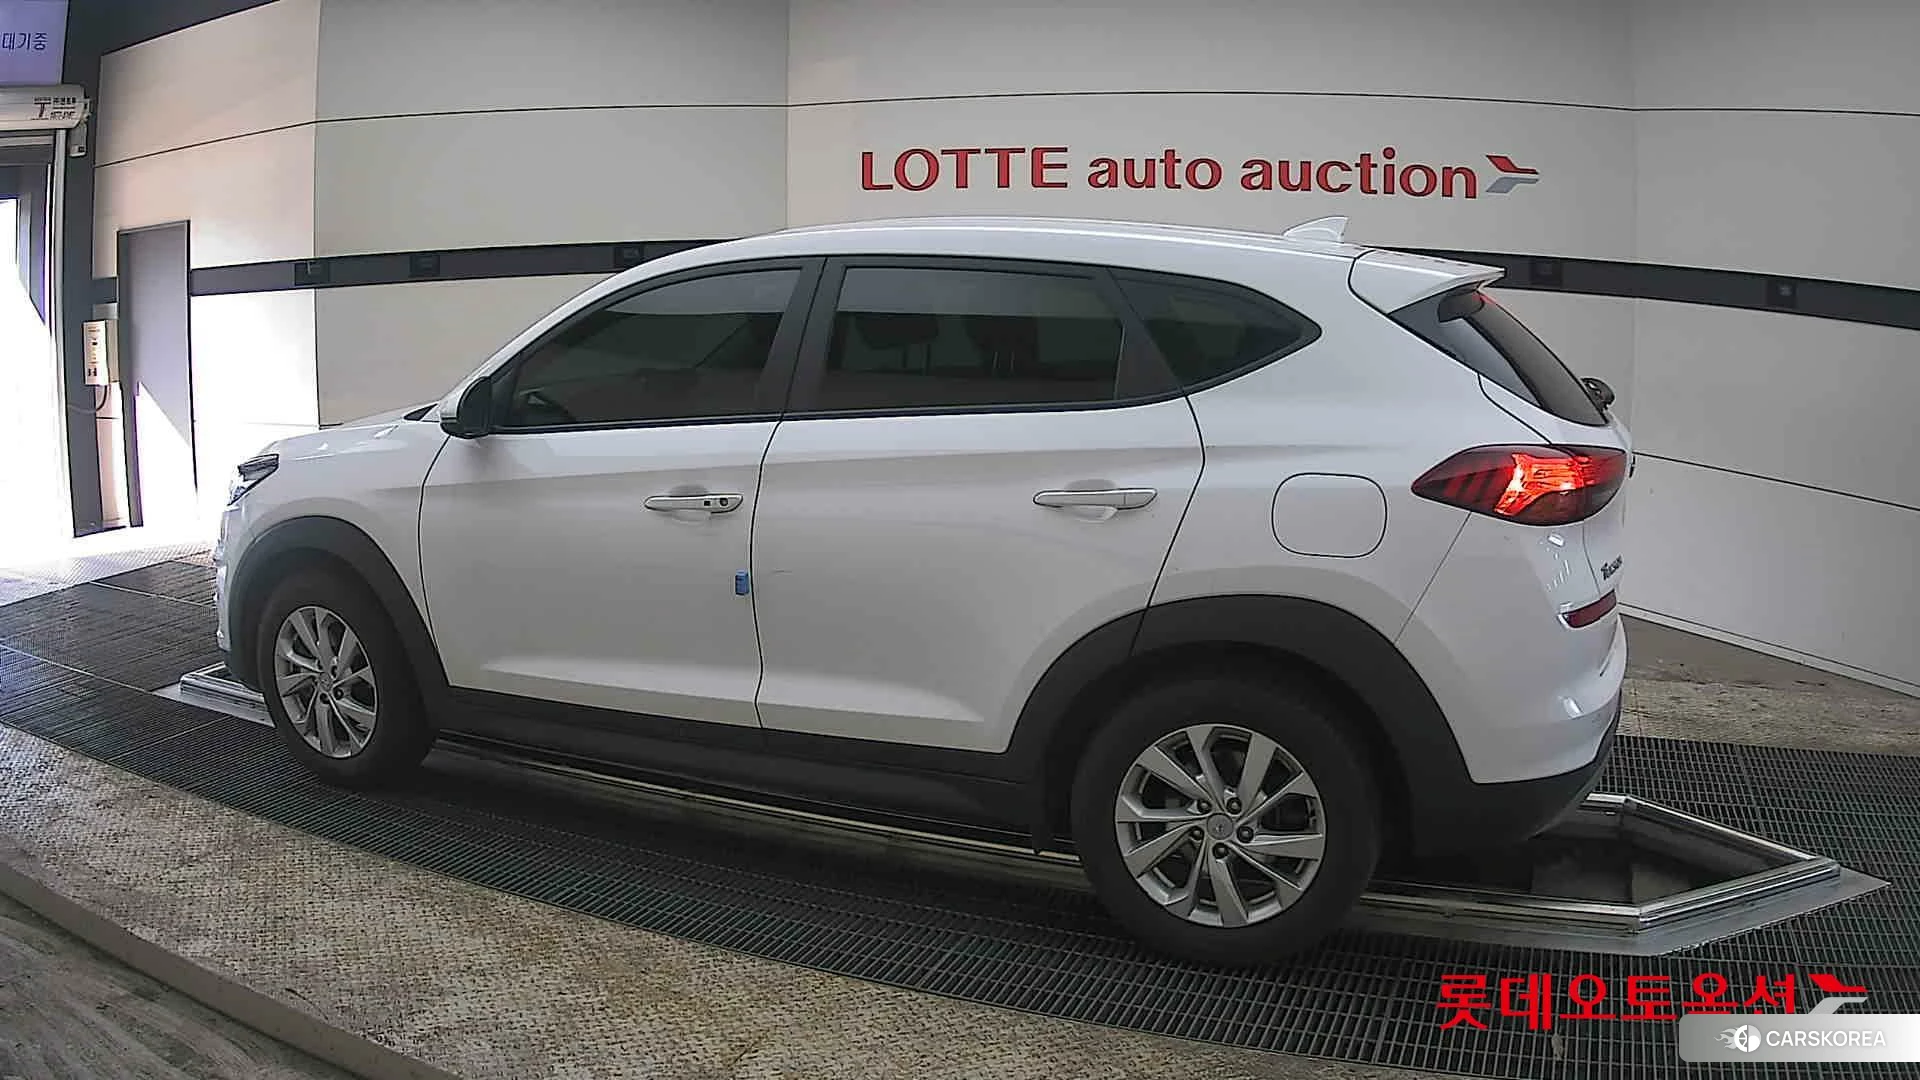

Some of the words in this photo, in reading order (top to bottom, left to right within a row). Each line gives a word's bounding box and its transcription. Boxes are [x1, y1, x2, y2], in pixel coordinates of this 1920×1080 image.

[862, 146, 1068, 192] LOTTE
[1088, 149, 1225, 189] auto
[1240, 147, 1478, 198] auction
